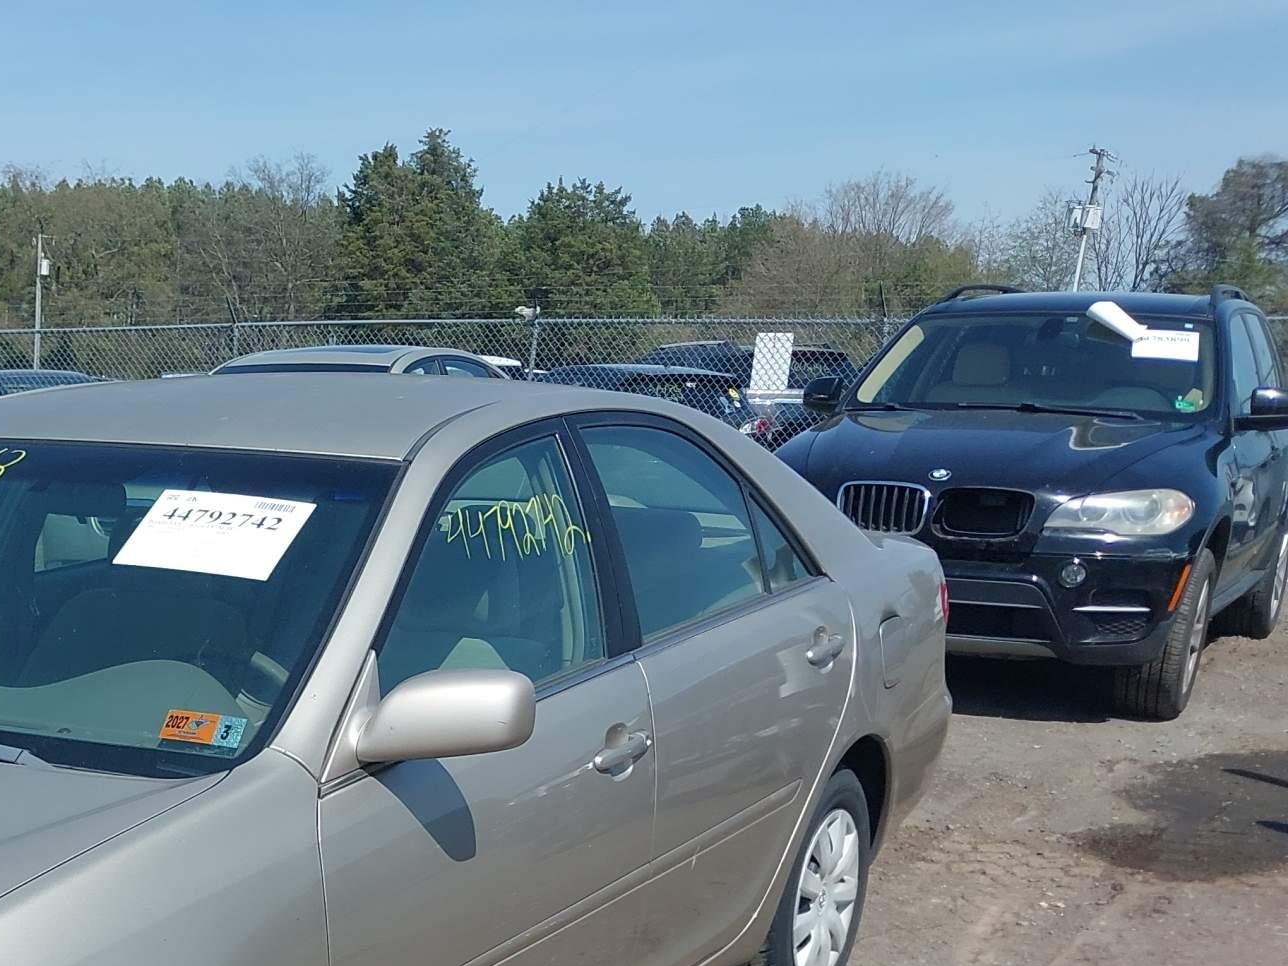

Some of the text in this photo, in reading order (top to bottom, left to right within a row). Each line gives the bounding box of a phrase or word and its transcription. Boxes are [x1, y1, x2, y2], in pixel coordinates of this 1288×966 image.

[163, 507, 283, 531] 44792742
[165, 715, 190, 729] 2027
[220, 725, 232, 740] 3
